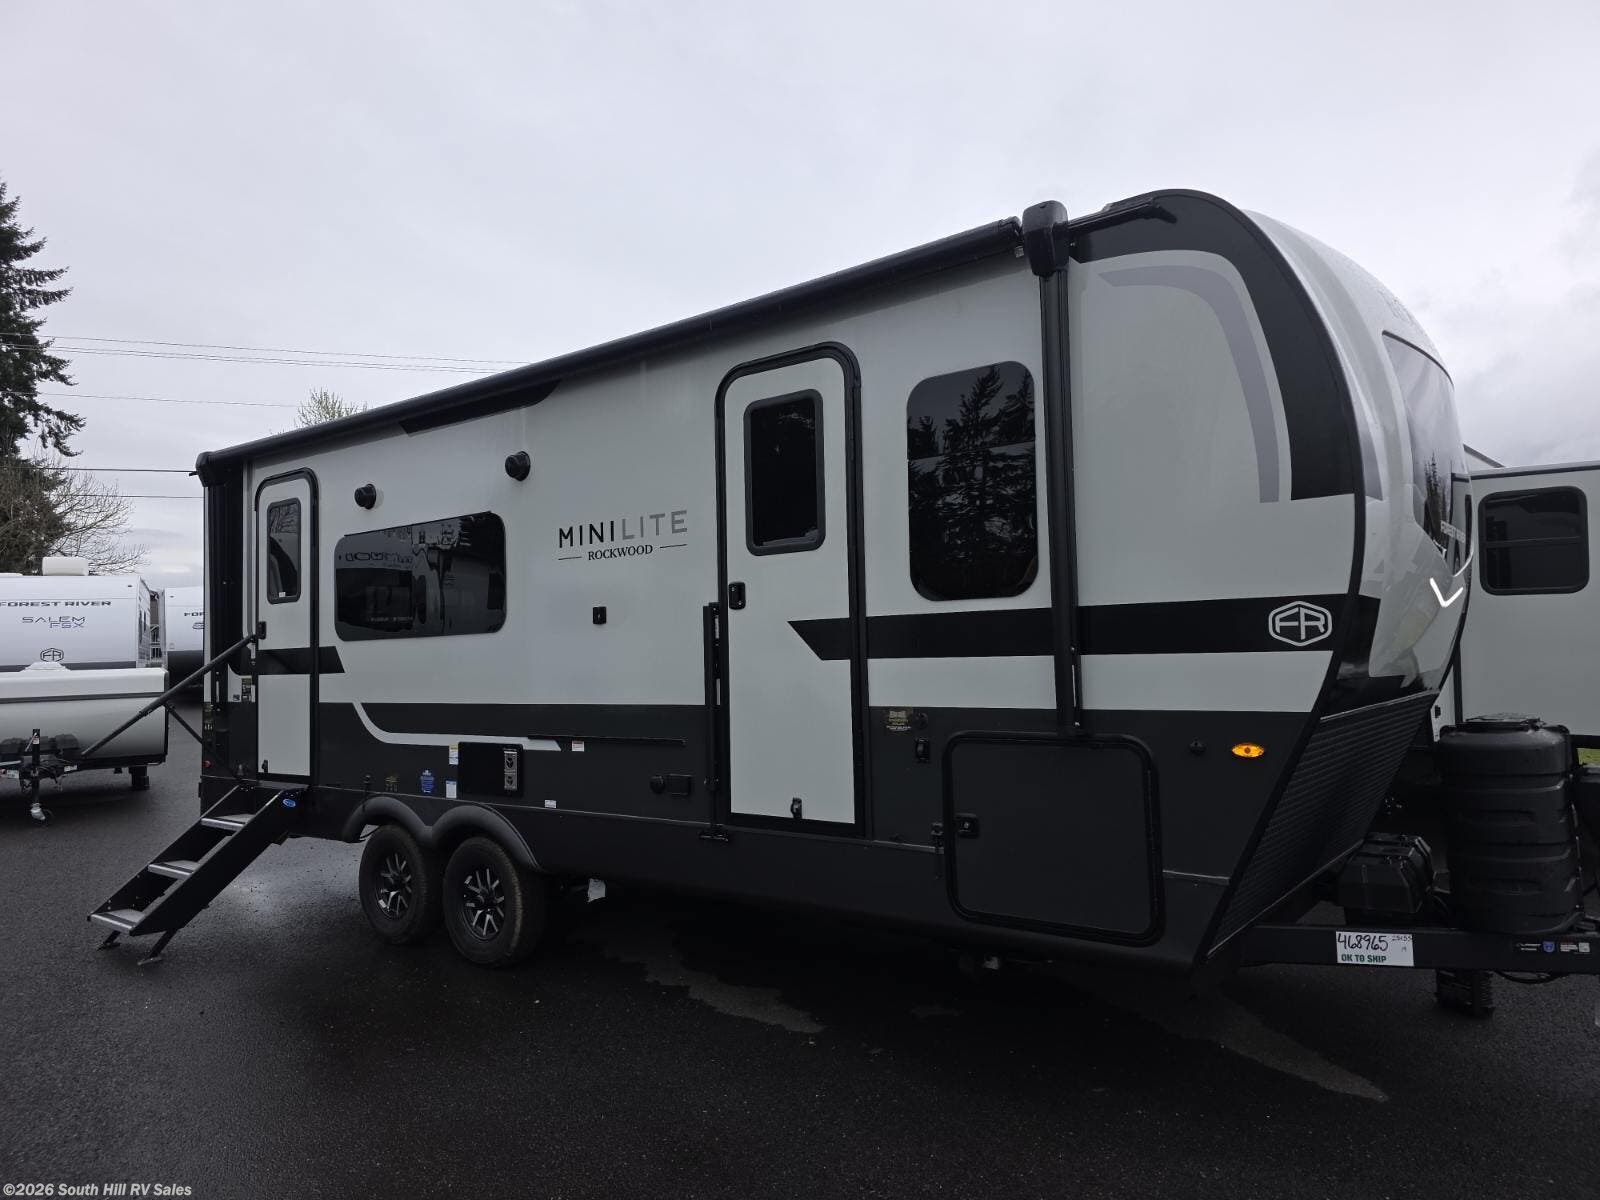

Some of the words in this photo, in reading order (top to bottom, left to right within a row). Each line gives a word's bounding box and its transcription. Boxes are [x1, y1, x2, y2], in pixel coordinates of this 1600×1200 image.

[588, 544, 654, 561] ROCKWOOD
[1338, 933, 1389, 952] 468965
[1341, 954, 1353, 962] OK
[1355, 954, 1365, 962] TO
[1367, 955, 1387, 963] SHIP
